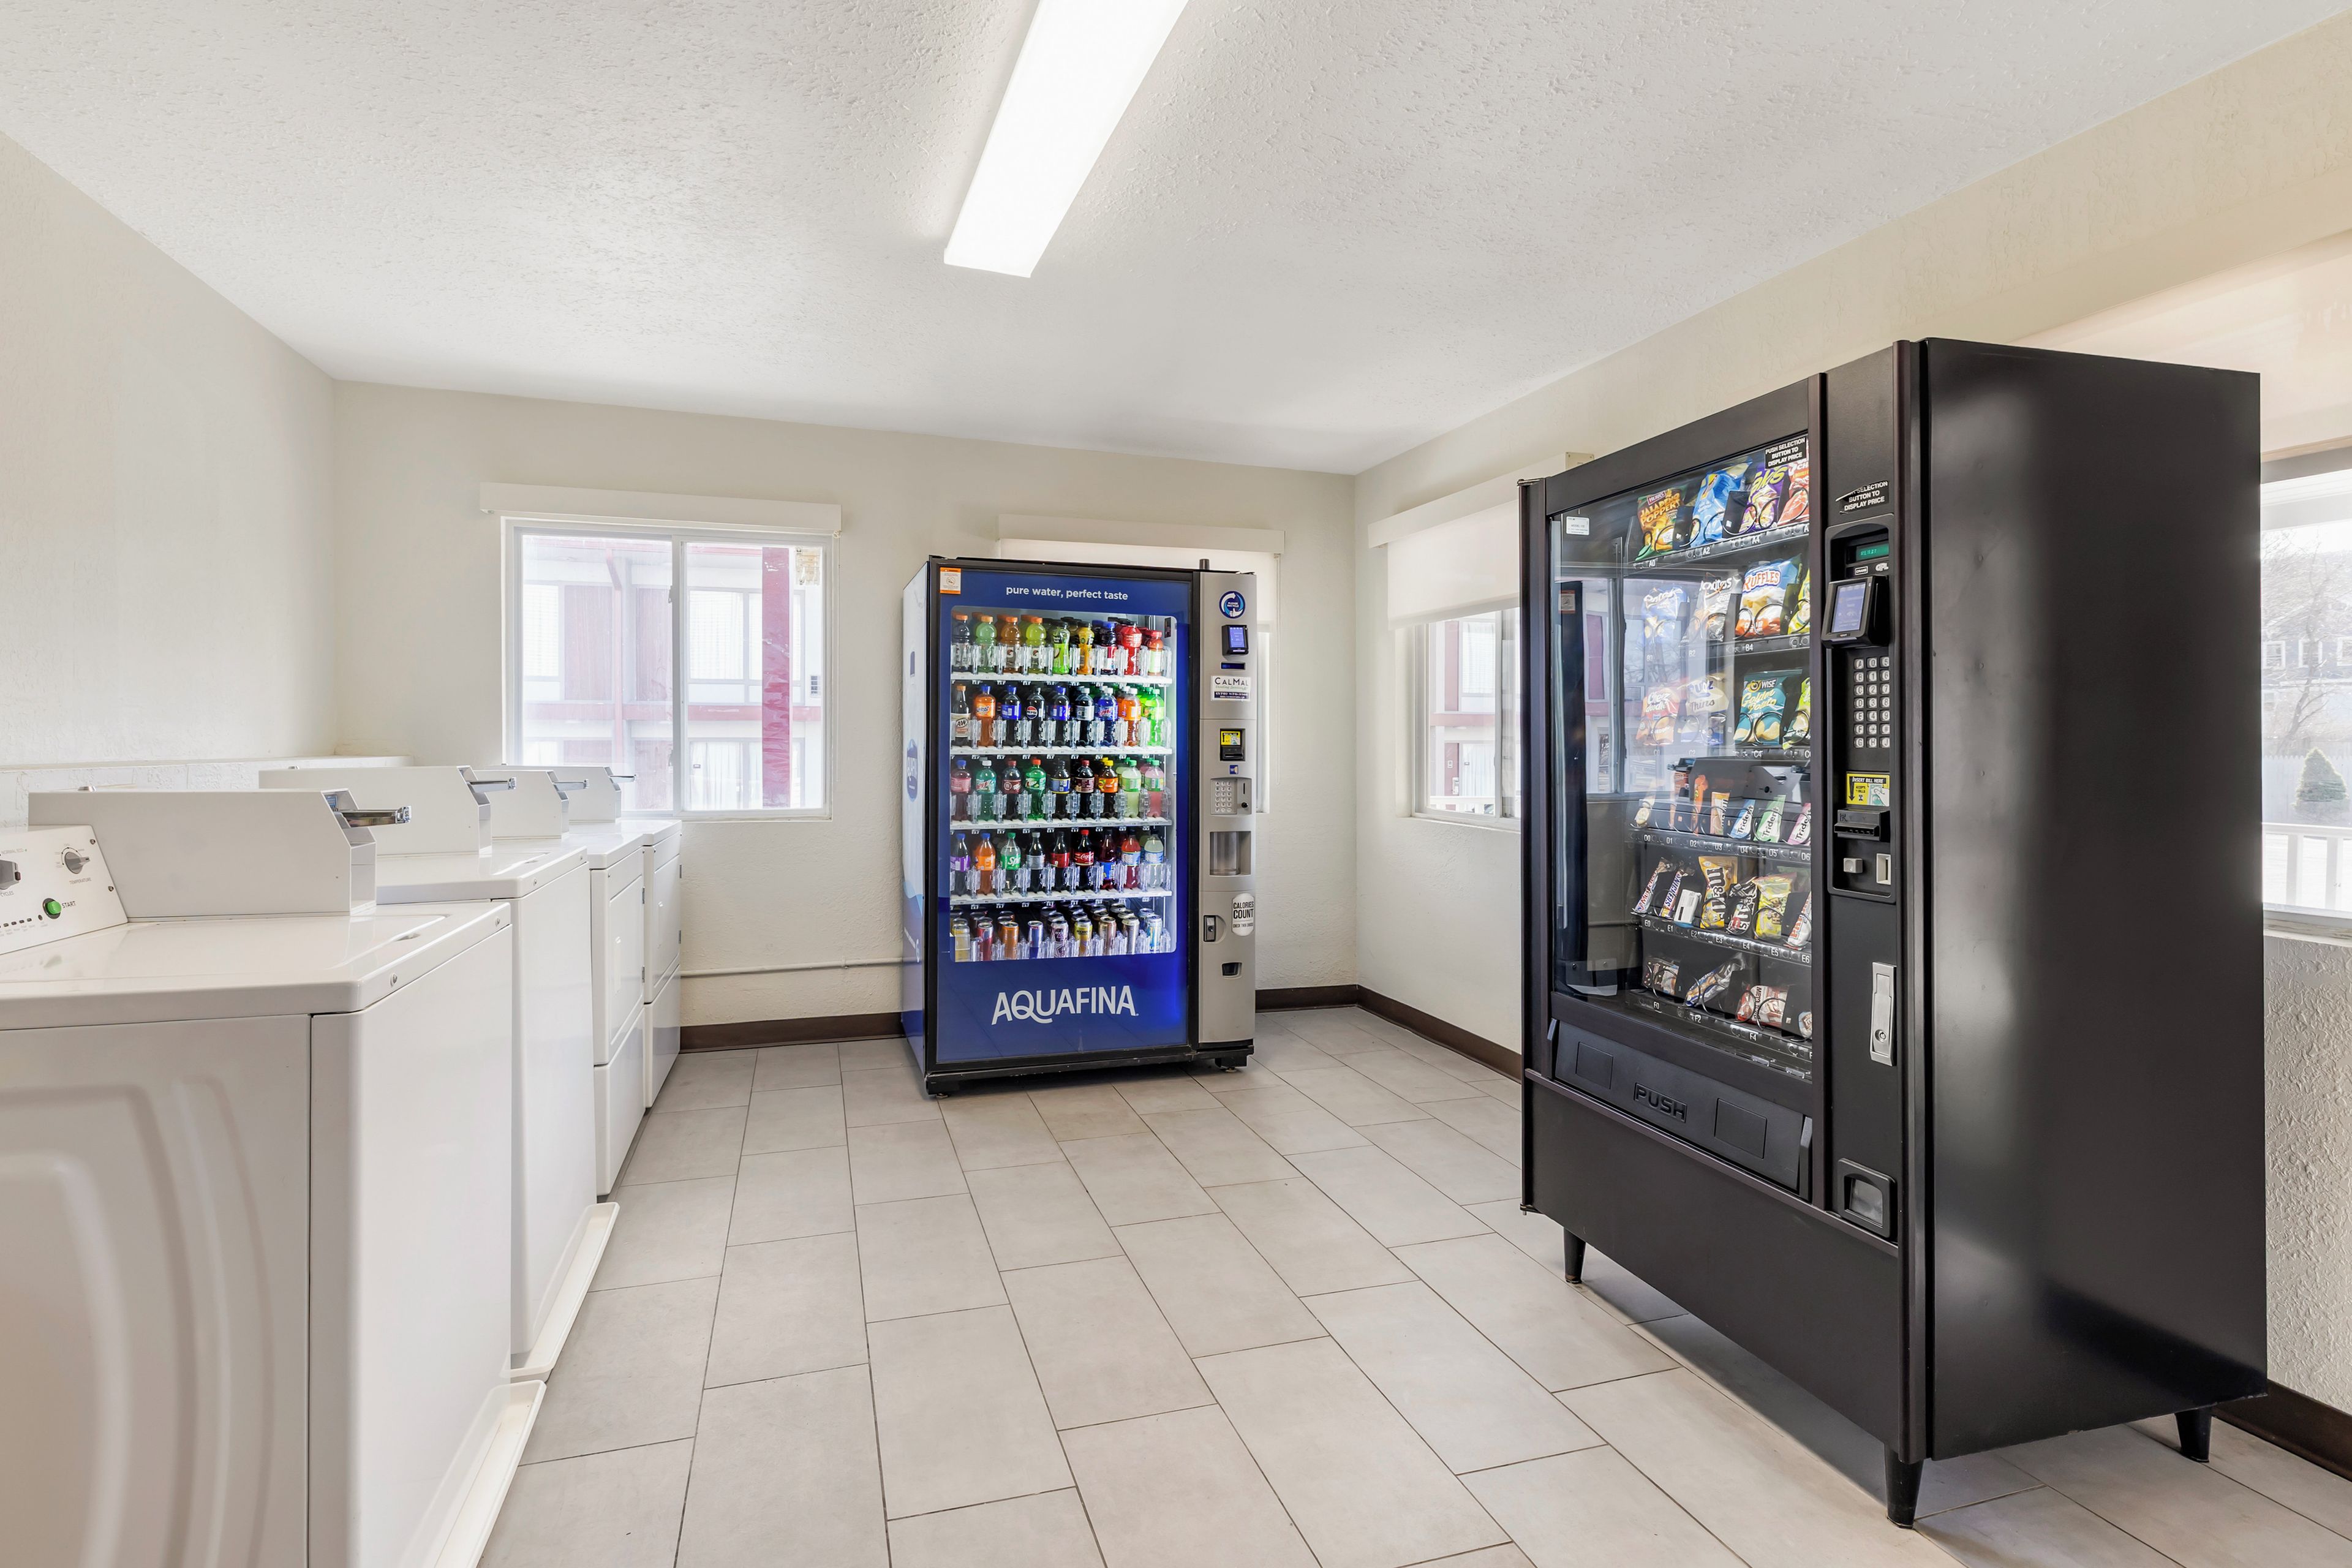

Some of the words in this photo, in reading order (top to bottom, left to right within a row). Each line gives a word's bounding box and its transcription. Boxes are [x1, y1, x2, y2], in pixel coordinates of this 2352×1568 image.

[1765, 446, 1777, 454] PUSH
[1779, 437, 1805, 451] SELECTION
[1768, 457, 1787, 467] DISPLAY
[1788, 452, 1803, 461] PRICE
[1772, 450, 1790, 459] BUTTON
[1857, 481, 1888, 494] SELECTION
[1844, 500, 1867, 511] DISPLAY
[1868, 496, 1885, 505] PRICE
[1849, 492, 1871, 503] BUTTON
[1744, 571, 1780, 590] RUFFLES
[1006, 586, 1030, 596] pure
[1032, 588, 1064, 598] water,
[1066, 588, 1102, 599] perfect
[1104, 590, 1128, 600] taste
[1762, 679, 1776, 689] WISE
[1234, 909, 1254, 919] COUNT
[1801, 954, 1810, 963] E6
[991, 985, 1136, 1025] AQUAFINA
[1695, 1014, 1702, 1023] F2
[1749, 1033, 1757, 1041] F4
[1636, 1087, 1686, 1121] PUSH
